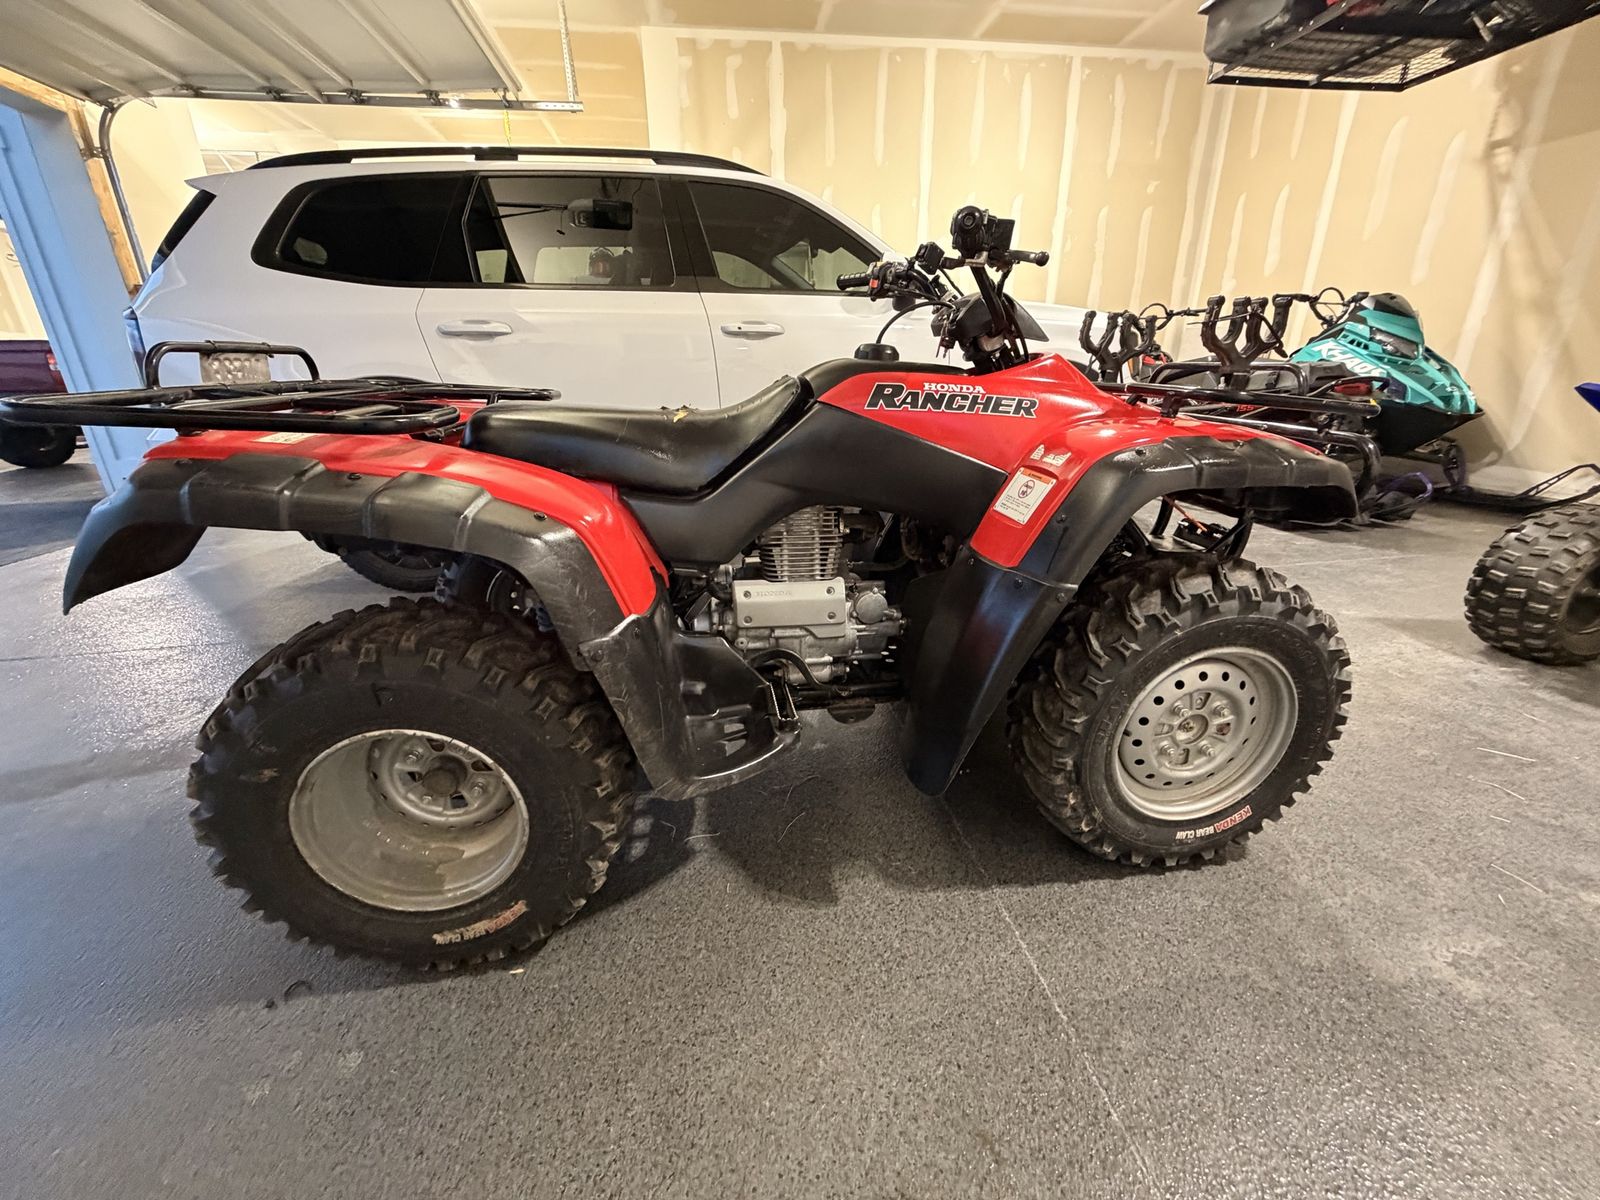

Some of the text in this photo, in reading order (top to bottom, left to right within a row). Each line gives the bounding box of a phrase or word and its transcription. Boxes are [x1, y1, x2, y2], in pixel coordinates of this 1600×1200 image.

[864, 382, 1038, 418] RANCHER
[924, 382, 986, 393] HONDA
[1175, 805, 1253, 840] KENDA BEAR CLAW
